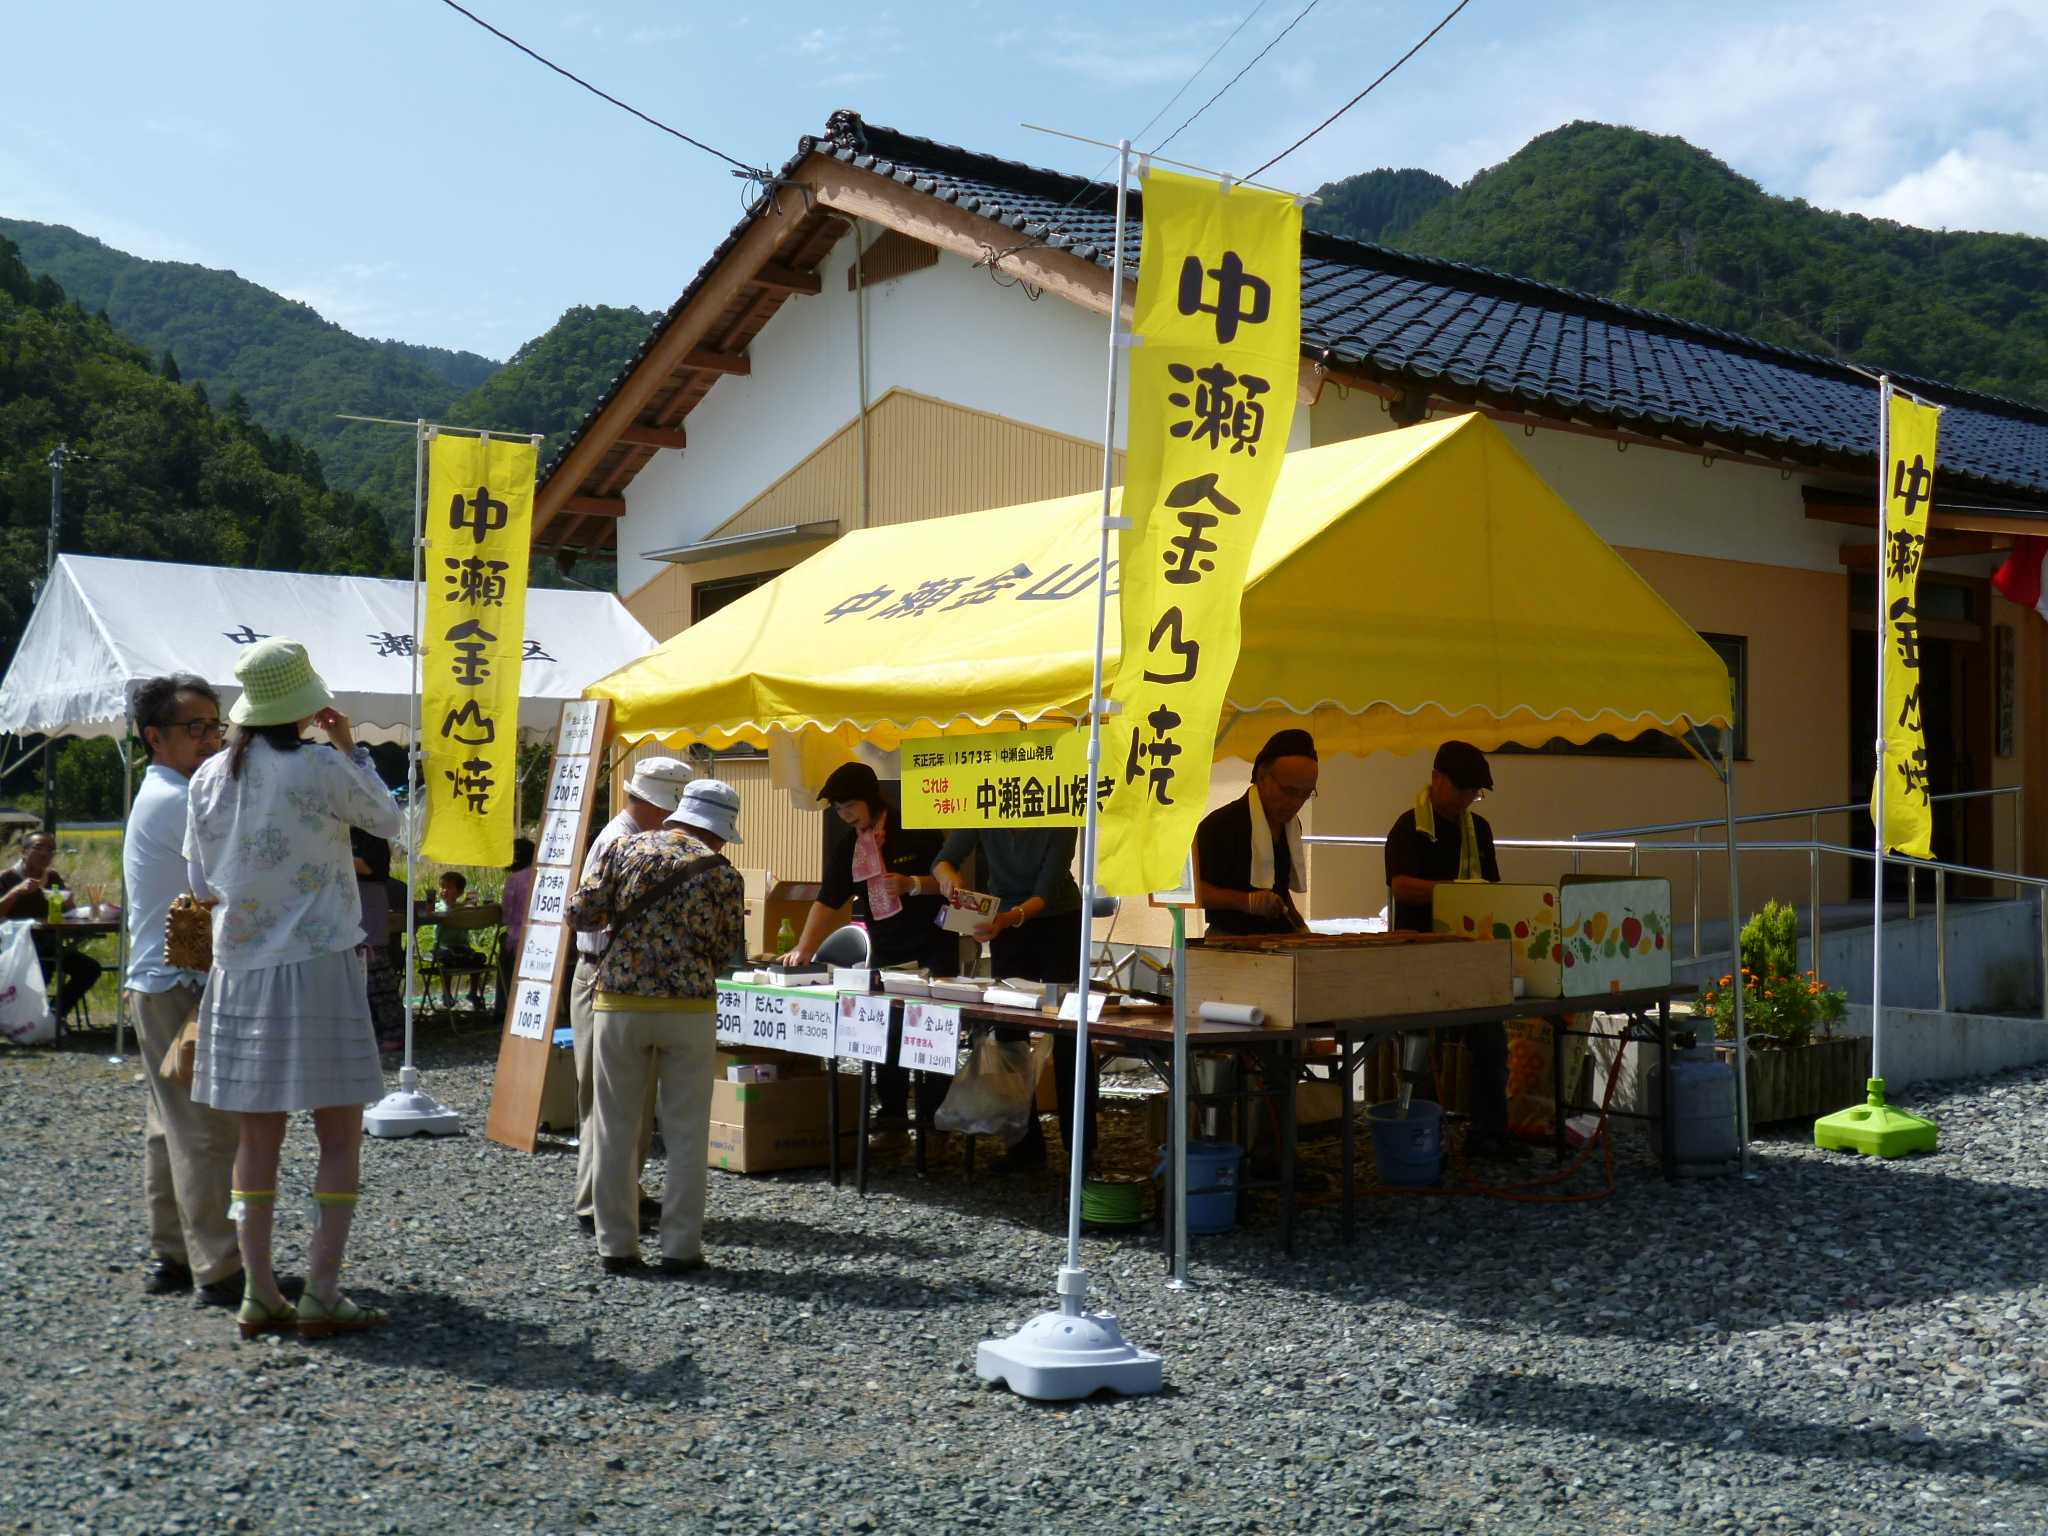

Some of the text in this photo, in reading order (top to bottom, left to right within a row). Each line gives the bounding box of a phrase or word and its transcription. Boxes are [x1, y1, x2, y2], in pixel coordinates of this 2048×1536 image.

[1126, 250, 1271, 806] 中瀬金山焼
[441, 486, 510, 815] 中瀬金山焼
[559, 764, 582, 780] だんご
[554, 785, 579, 802] 200円
[921, 777, 949, 794] これは
[547, 847, 565, 859] 250円
[538, 873, 565, 890] おつまみ
[535, 895, 560, 914] 150円
[524, 990, 541, 1007] お茶
[755, 995, 784, 1015] だんご
[517, 1010, 542, 1031] 100円
[801, 1008, 832, 1025] 金山うどん
[858, 1006, 885, 1026] 金山焼
[753, 1019, 787, 1041] 200円
[924, 1015, 954, 1036] 金山焼
[861, 1043, 883, 1058] 120円
[929, 1054, 952, 1069] 120円
